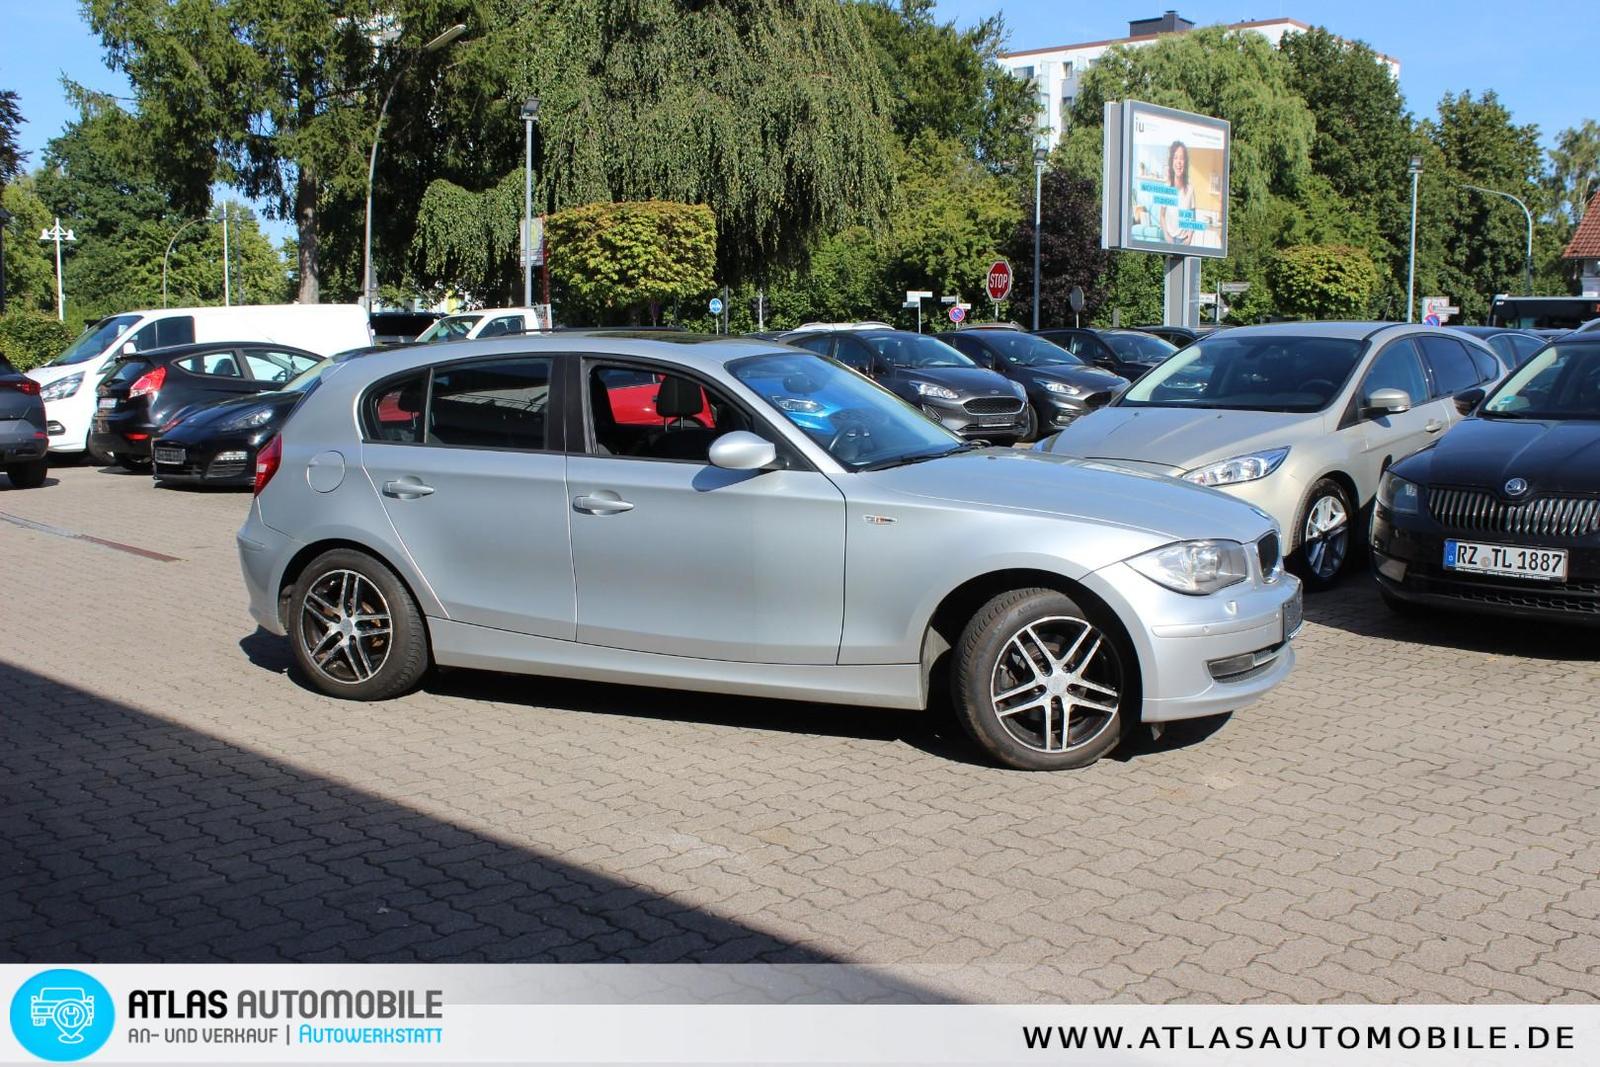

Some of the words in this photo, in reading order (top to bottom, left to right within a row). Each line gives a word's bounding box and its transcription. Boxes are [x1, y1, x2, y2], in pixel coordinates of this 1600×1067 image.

[989, 274, 1008, 289] STOP
[1457, 545, 1478, 565] RZ
[1491, 548, 1512, 568] TL
[1518, 551, 1562, 573] 1887
